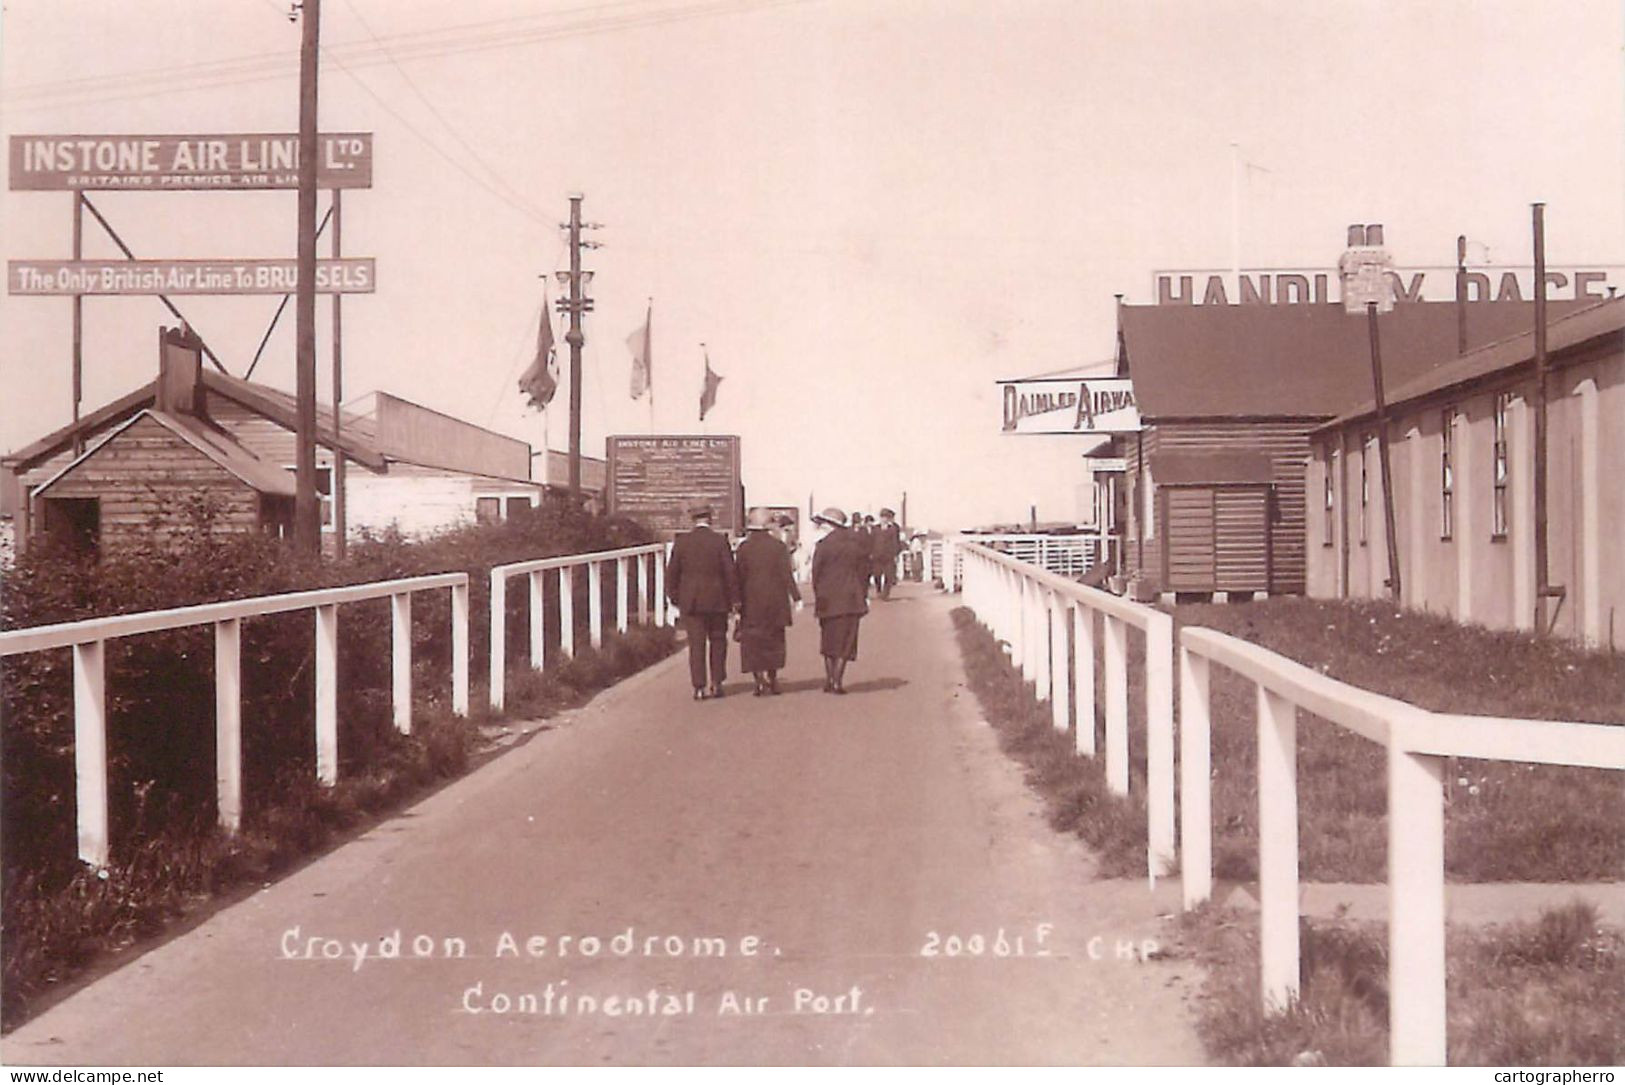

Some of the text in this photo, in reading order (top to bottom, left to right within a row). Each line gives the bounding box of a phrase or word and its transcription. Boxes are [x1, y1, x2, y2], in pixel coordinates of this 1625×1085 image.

[24, 141, 160, 171] INSTONE
[172, 141, 228, 171] AIR
[241, 175, 267, 184] AIR
[275, 174, 300, 184] LIN
[18, 267, 54, 288] The
[58, 267, 97, 292] Only
[101, 267, 164, 288] British
[234, 267, 252, 287] To
[256, 266, 368, 287] BRUSELS
[1159, 274, 1426, 303] HANDY
[1002, 383, 1136, 431] DAIMLER AIRWA
